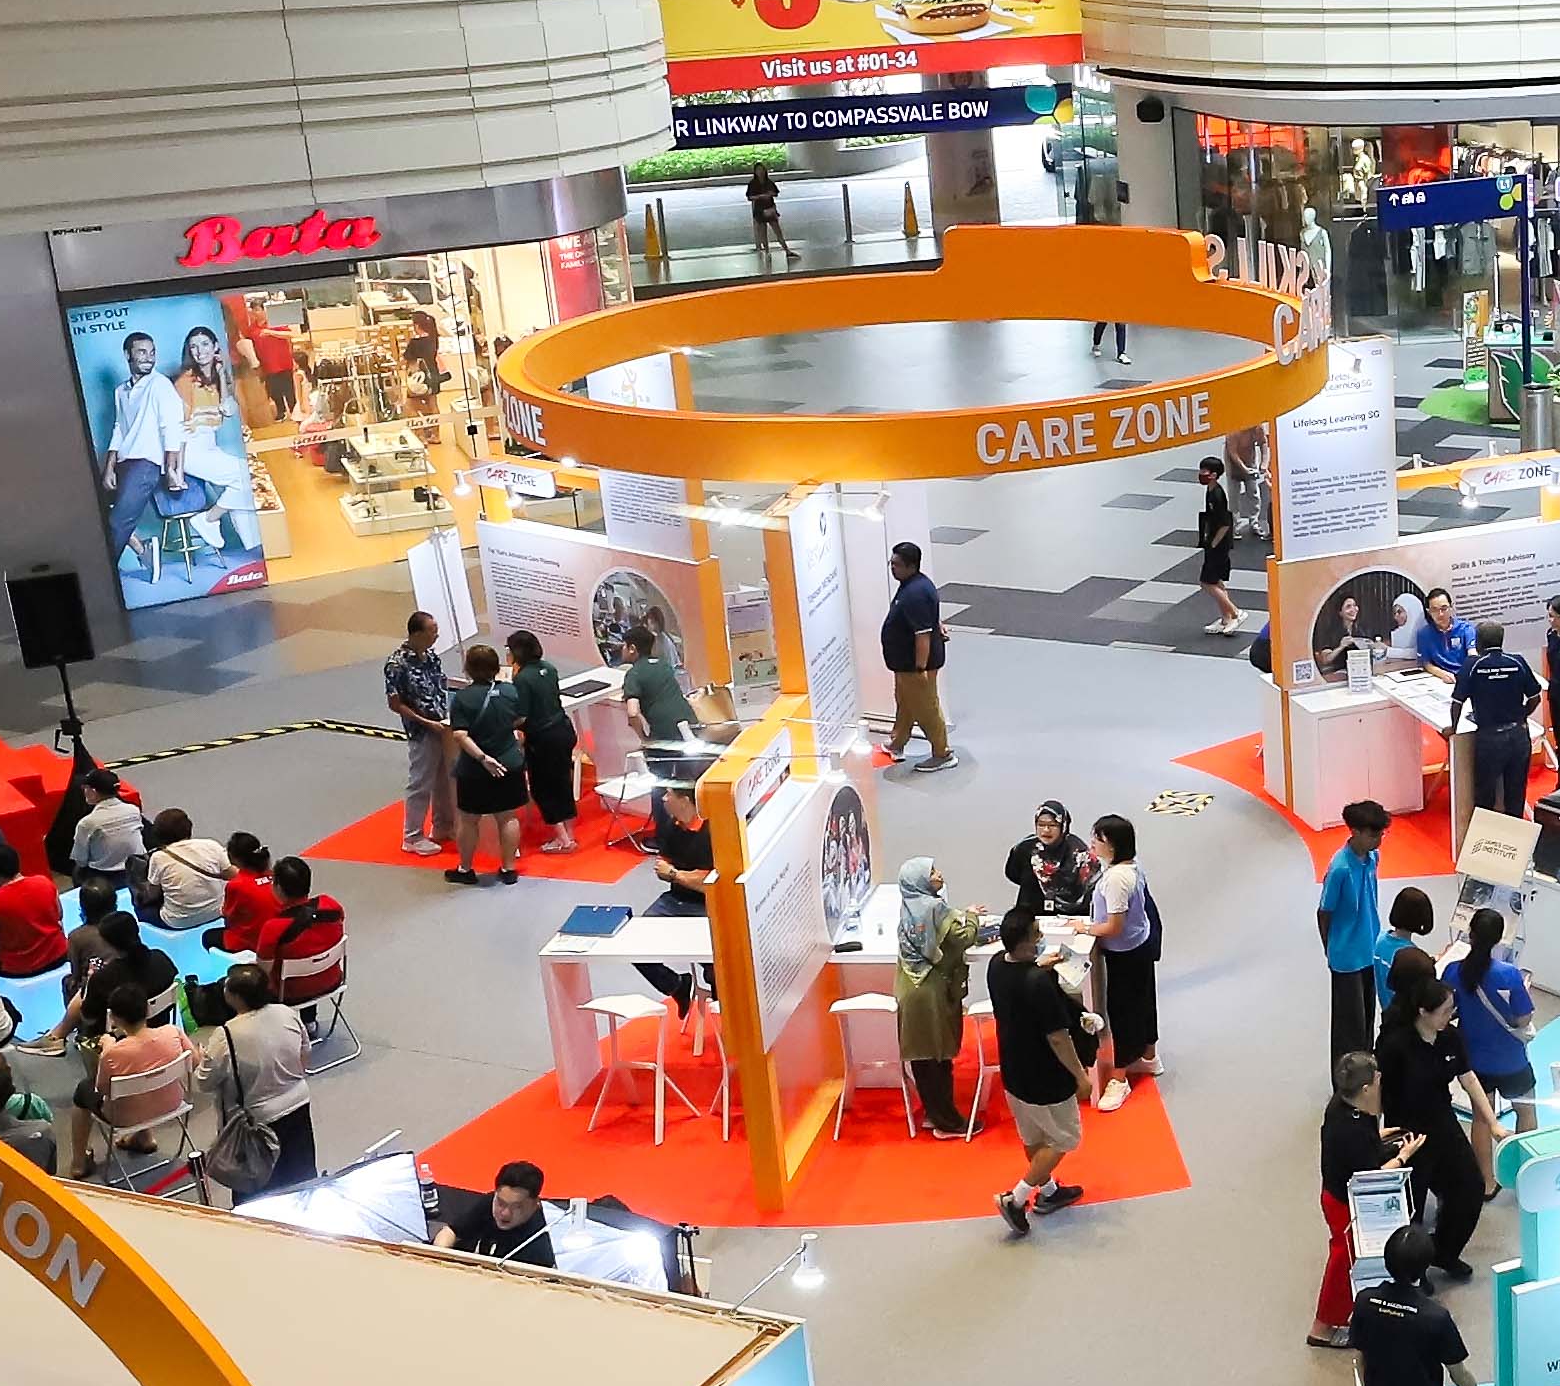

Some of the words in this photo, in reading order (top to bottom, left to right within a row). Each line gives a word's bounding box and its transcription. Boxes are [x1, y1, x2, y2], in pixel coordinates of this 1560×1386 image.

[761, 58, 806, 78] Visit
[810, 61, 832, 75] us
[836, 56, 855, 73] at
[857, 51, 917, 71] #01-34
[694, 114, 778, 135] LINKWAY
[783, 112, 807, 129] TO
[812, 104, 944, 128] COMPASSVALE
[949, 101, 988, 119] BOW
[179, 208, 382, 268] Bata
[559, 236, 582, 252] WE
[68, 308, 101, 323] STEP
[104, 307, 130, 319] OUT
[73, 326, 86, 335] IN
[89, 321, 126, 333] STYLE
[975, 411, 1096, 466] CARE
[1110, 391, 1212, 449] ZONE
[1293, 418, 1327, 428] Lifelong
[1329, 413, 1366, 424] Learning
[1368, 410, 1380, 419] SG
[485, 467, 508, 483] CARE
[510, 471, 537, 487] ZONE
[1484, 469, 1515, 483] CARE
[1518, 465, 1551, 480] ZONE
